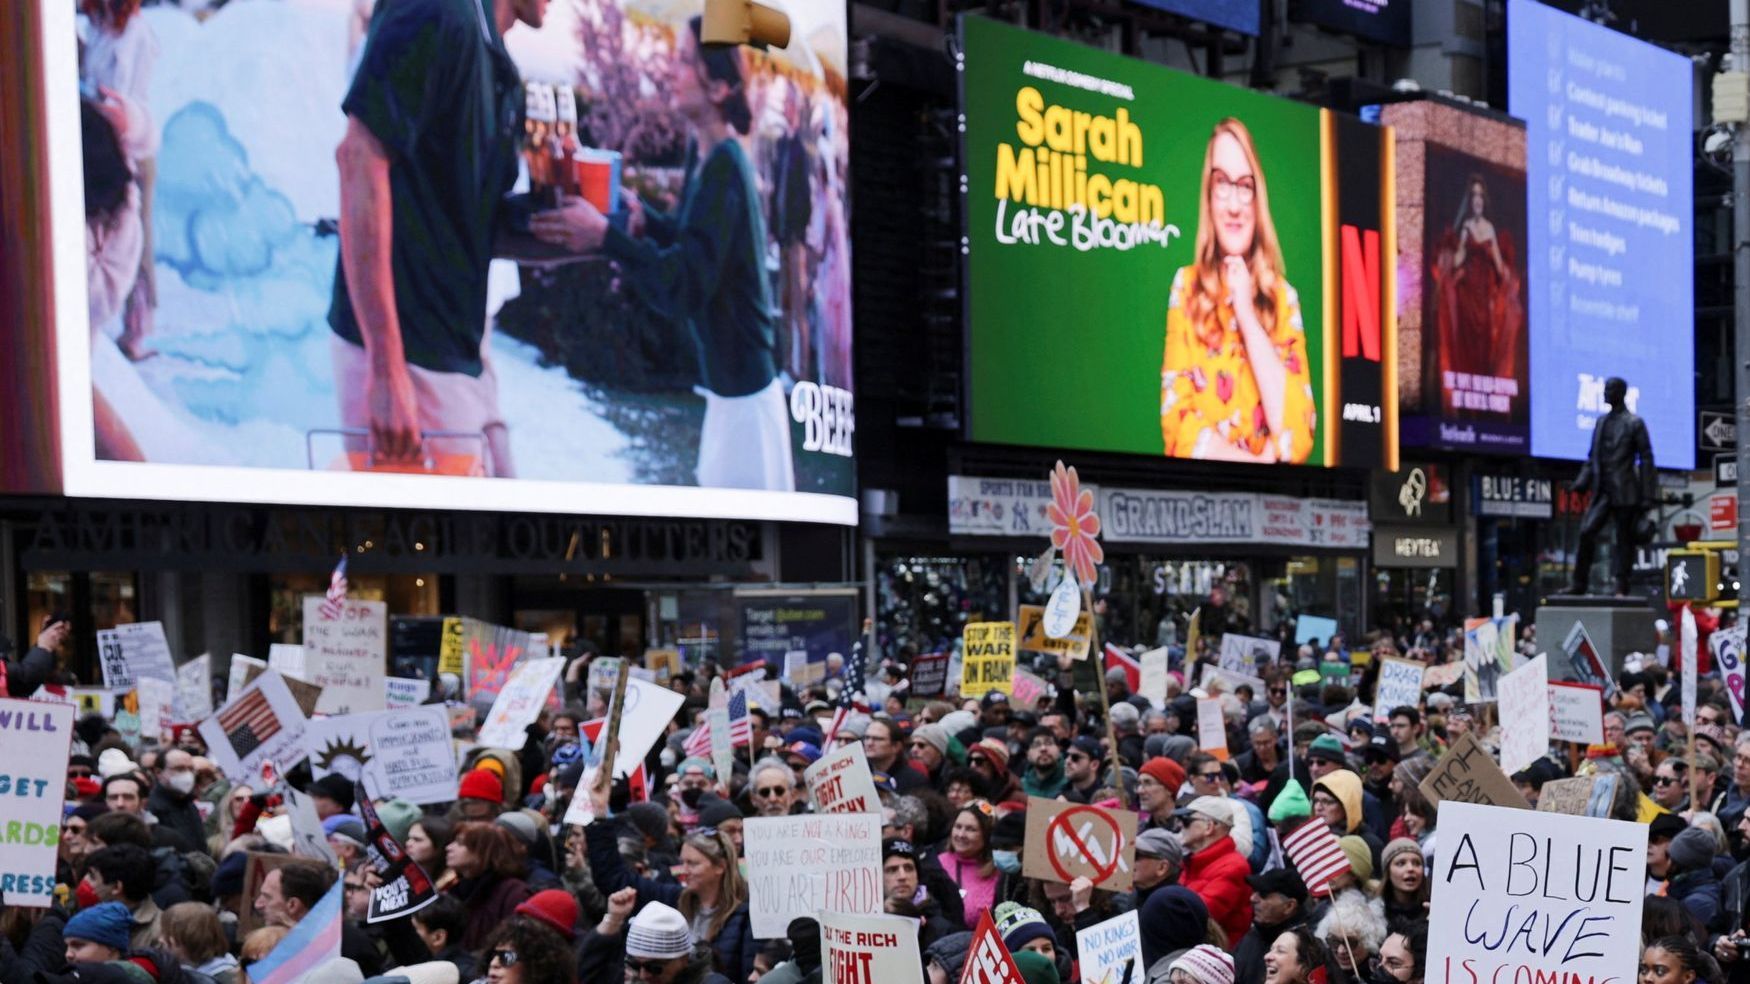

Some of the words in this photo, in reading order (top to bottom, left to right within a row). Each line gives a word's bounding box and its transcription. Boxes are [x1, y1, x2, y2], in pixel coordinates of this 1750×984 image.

[1016, 87, 1143, 168] Sarah
[995, 143, 1165, 228] Millican
[995, 198, 1068, 248] Late
[1070, 203, 1181, 252] Bloomer
[1341, 224, 1381, 361] N
[1342, 403, 1373, 421] APRIL
[1482, 475, 1522, 501] BLUE
[1526, 479, 1551, 503] FIN
[31, 509, 342, 552] AMERICAN
[350, 512, 496, 557] EAGLE
[507, 514, 751, 563] OUTFITTERS
[1395, 537, 1441, 558] HEYTEA
[966, 626, 989, 642] STOP
[993, 626, 1012, 641] THE
[966, 643, 1011, 657] WAR
[964, 661, 978, 683] ON
[1382, 663, 1420, 685] DRAG
[1380, 685, 1419, 702] KINGS
[830, 756, 855, 773] RICH
[0, 820, 60, 848] RDS
[750, 823, 772, 840] YOU
[776, 823, 799, 839] ARE
[802, 821, 822, 838] NOT
[825, 823, 833, 837] A
[835, 821, 871, 840] KING!
[747, 850, 770, 867] YOU
[772, 850, 794, 865] ARE
[800, 847, 826, 865] OUR
[1445, 831, 1486, 891] A
[1506, 830, 1634, 904] BLUE
[380, 890, 409, 913] NEXT
[753, 873, 780, 914] YOU
[786, 872, 817, 914] ARE
[824, 867, 880, 914] FIRED!
[835, 929, 852, 946] THE
[856, 932, 898, 948] RICH
[1083, 932, 1101, 952] NO
[1103, 919, 1137, 945] KINGS
[1463, 897, 1616, 965] WAVE
[1097, 946, 1116, 967] NO
[1115, 939, 1139, 960] WAR
